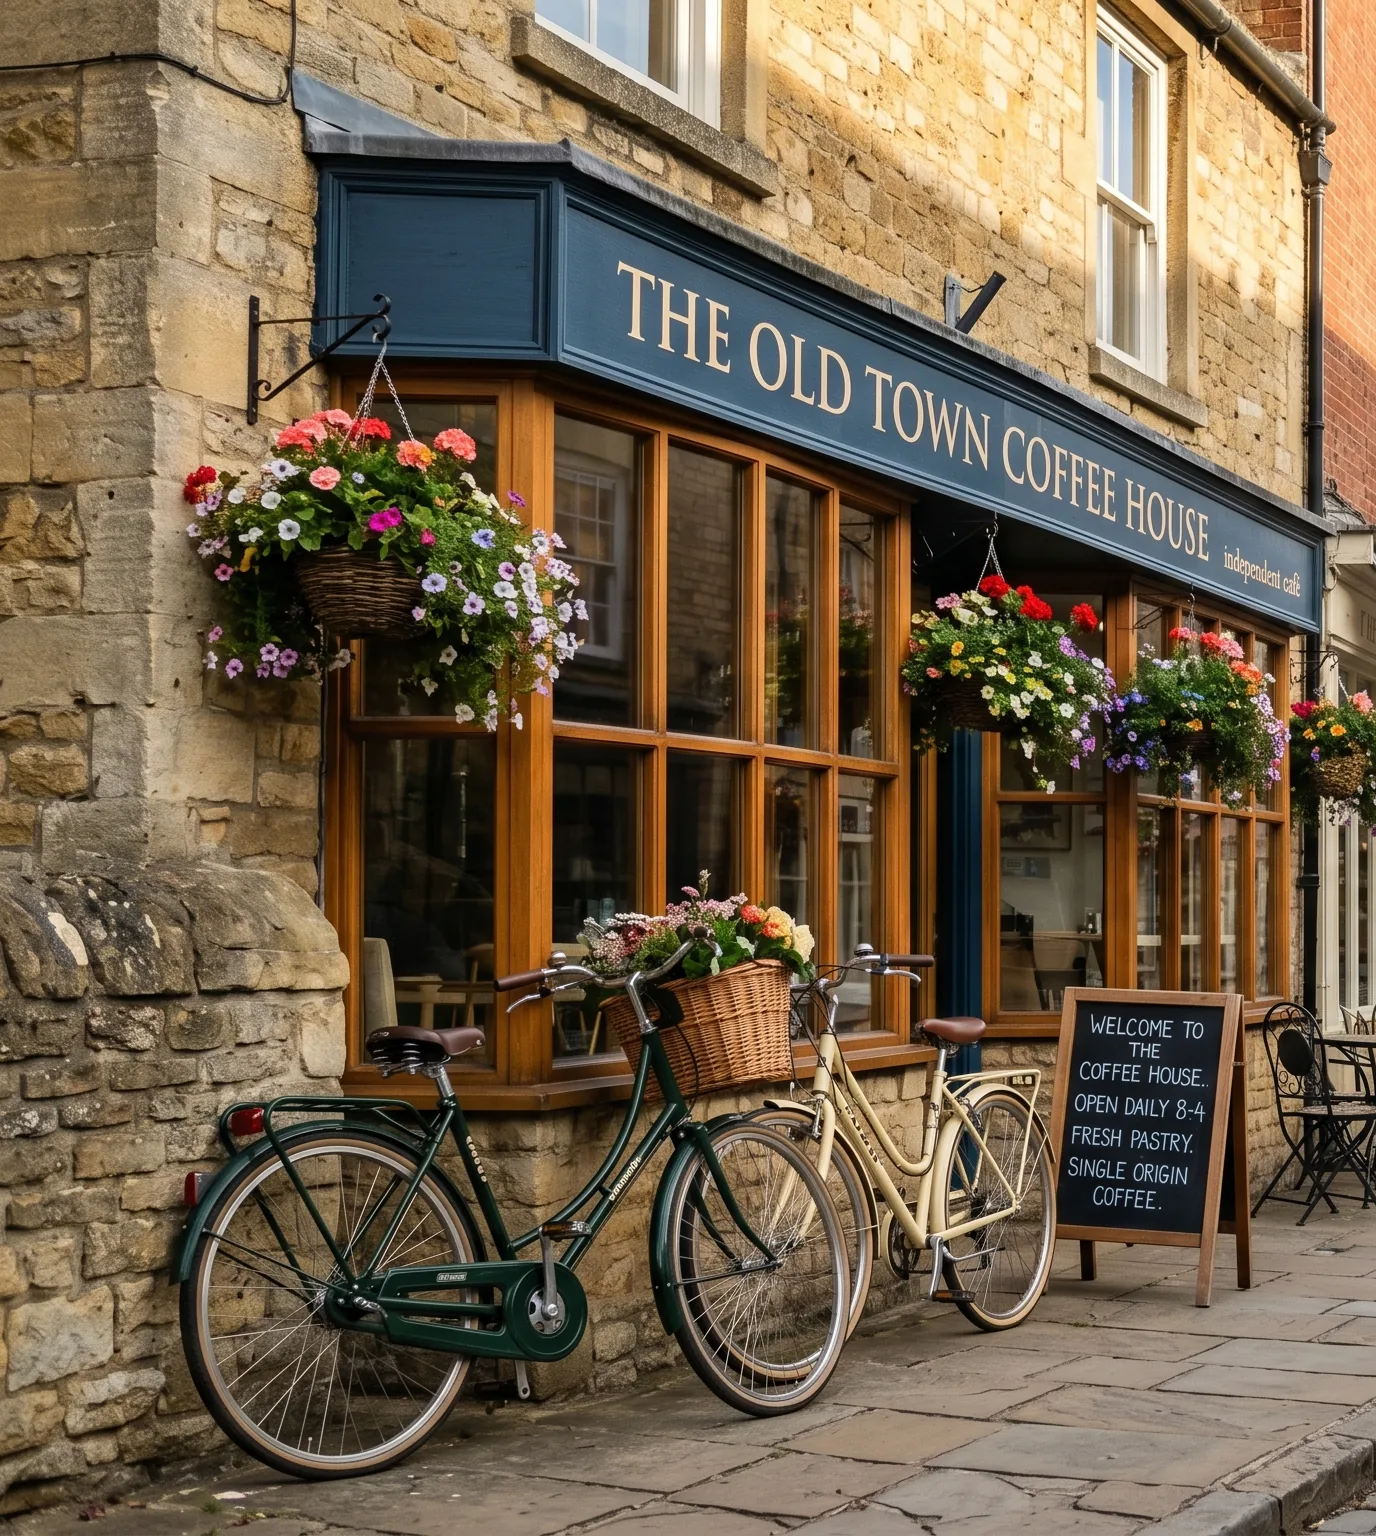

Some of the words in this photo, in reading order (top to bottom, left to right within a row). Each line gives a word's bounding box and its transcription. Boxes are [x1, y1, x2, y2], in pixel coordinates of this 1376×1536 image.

[616, 260, 731, 374] THE
[749, 322, 852, 416] OLD
[864, 364, 991, 471] TOWN
[1001, 426, 1117, 522] COFFEE
[1125, 478, 1210, 562] HOUSE
[1223, 545, 1281, 589] independent
[1090, 1013, 1174, 1038] WELCOME
[1182, 1020, 1204, 1040] TO
[1128, 1041, 1162, 1059] THE
[1079, 1061, 1142, 1083] COFFEE
[1074, 1093, 1119, 1114] OPEN
[1124, 1097, 1170, 1118] DAILY
[1175, 1099, 1206, 1123] 8-4
[1071, 1125, 1122, 1147] FRESH
[1067, 1156, 1127, 1180] SINGLE
[1133, 1162, 1189, 1185] ORIGIN
